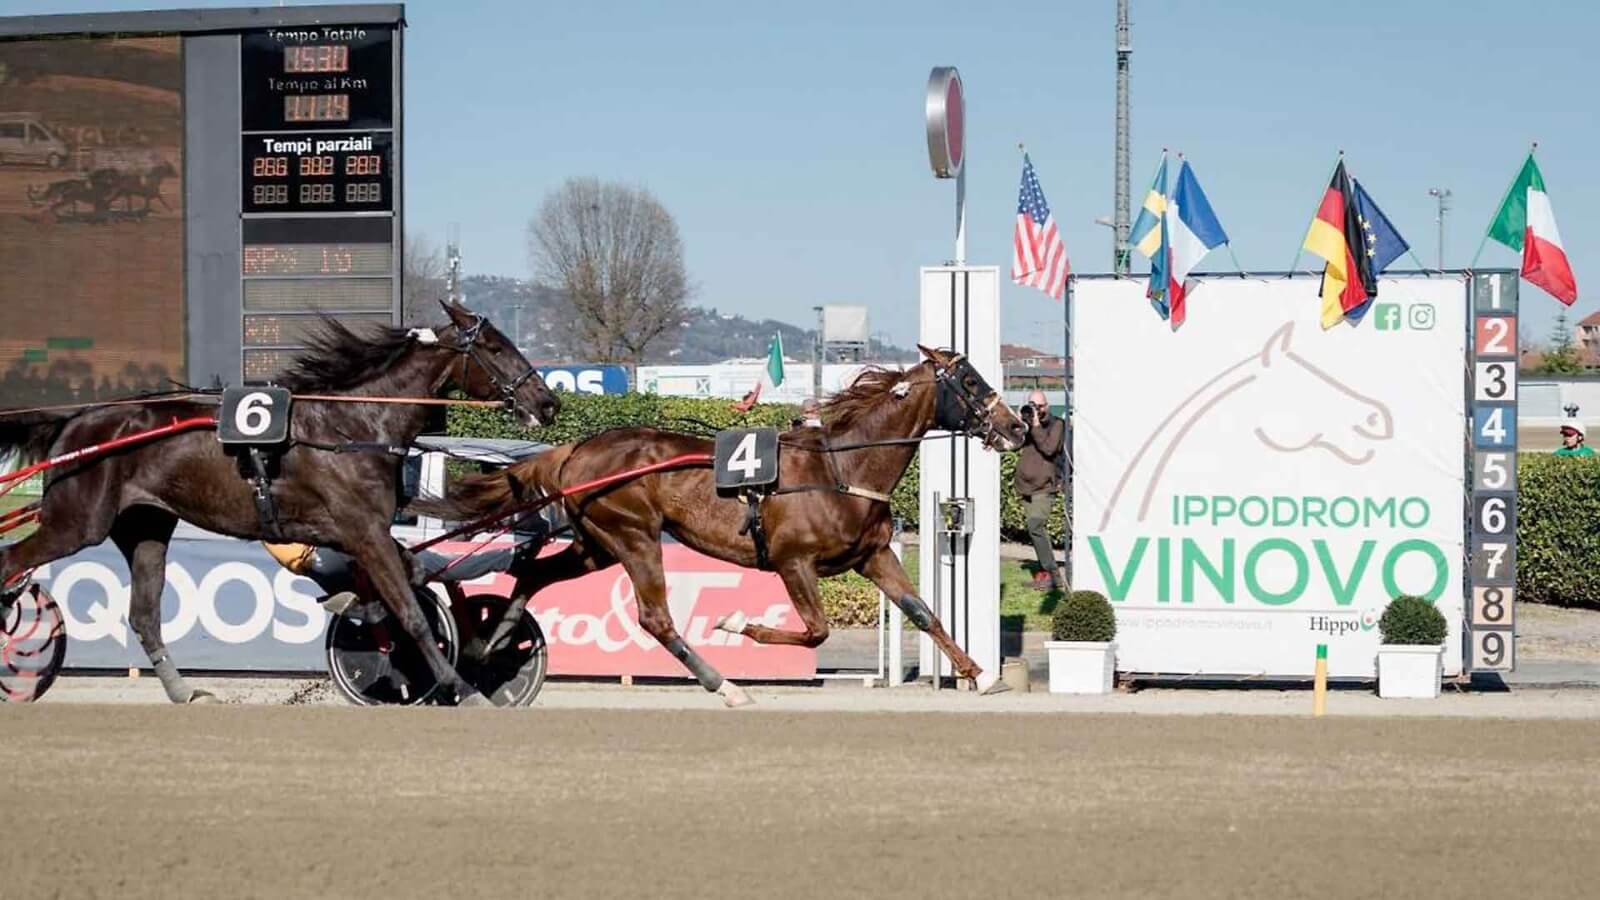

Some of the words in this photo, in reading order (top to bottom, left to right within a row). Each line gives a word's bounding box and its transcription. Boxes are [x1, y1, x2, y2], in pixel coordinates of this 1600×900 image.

[267, 29, 318, 44] Tempo
[322, 28, 366, 40] Totale
[269, 78, 318, 93] Tempo
[324, 77, 337, 89] al
[340, 77, 368, 89] Km
[263, 138, 312, 155] Tempi
[316, 137, 373, 155] parziali
[1488, 273, 1502, 310] 1
[1483, 318, 1509, 353] 2
[1484, 364, 1507, 399] 3
[234, 391, 273, 437] 6
[1481, 407, 1507, 444] 4
[727, 432, 762, 479] 4
[1482, 453, 1507, 489] 5
[1172, 495, 1431, 529] IPPODROMO
[1481, 498, 1507, 534] 6
[1087, 536, 1449, 606] VINOVO
[1482, 543, 1507, 579] 7
[1482, 587, 1506, 624] 8
[1310, 616, 1360, 634] Hippo
[1481, 632, 1506, 667] 9
